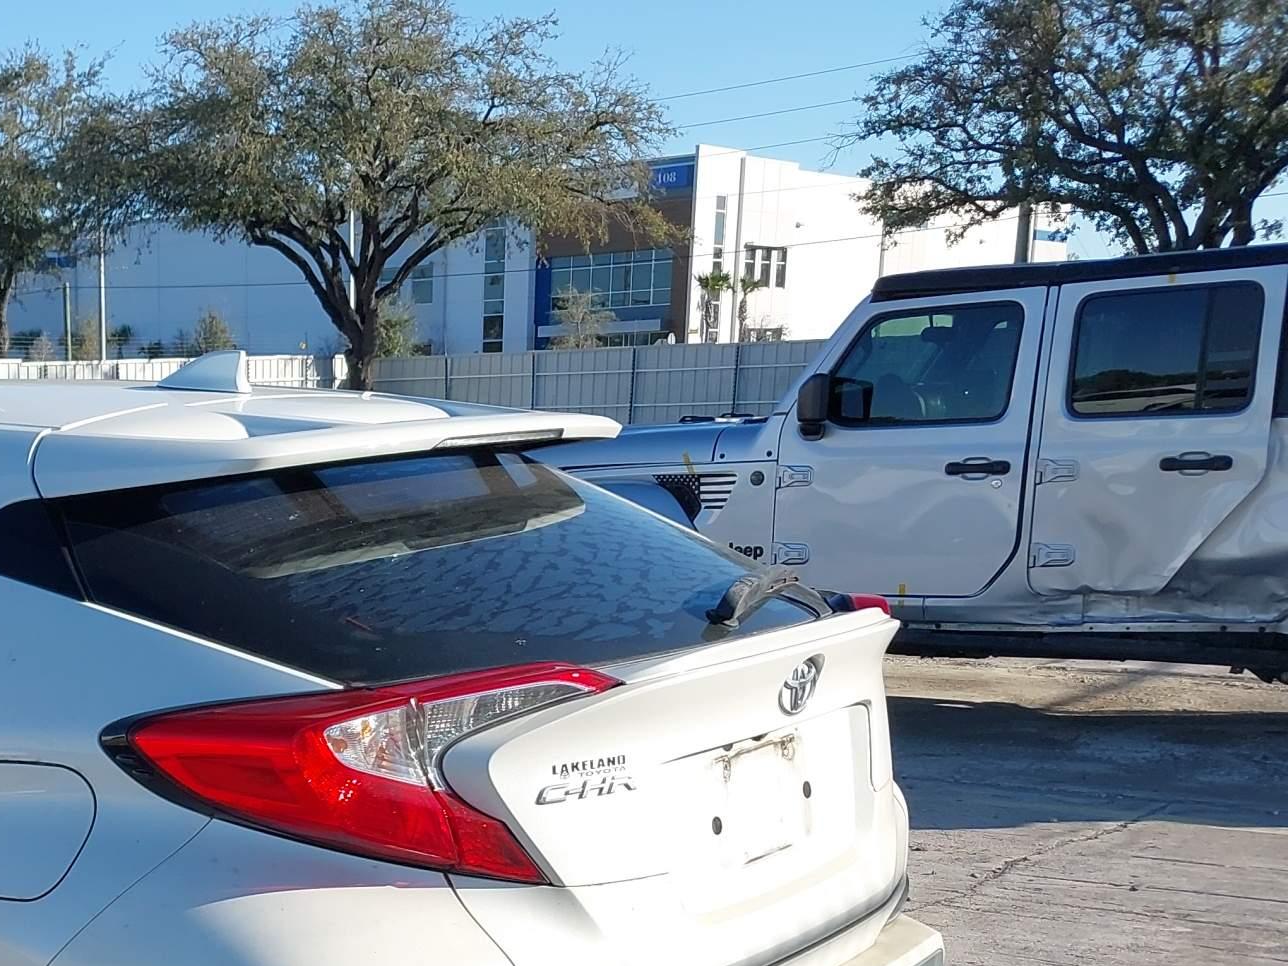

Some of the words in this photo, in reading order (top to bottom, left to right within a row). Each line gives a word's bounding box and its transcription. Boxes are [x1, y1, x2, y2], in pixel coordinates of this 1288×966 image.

[552, 754, 626, 776] LAKELAND
[577, 766, 626, 778] TOYOTA
[534, 777, 637, 806] C-HR
